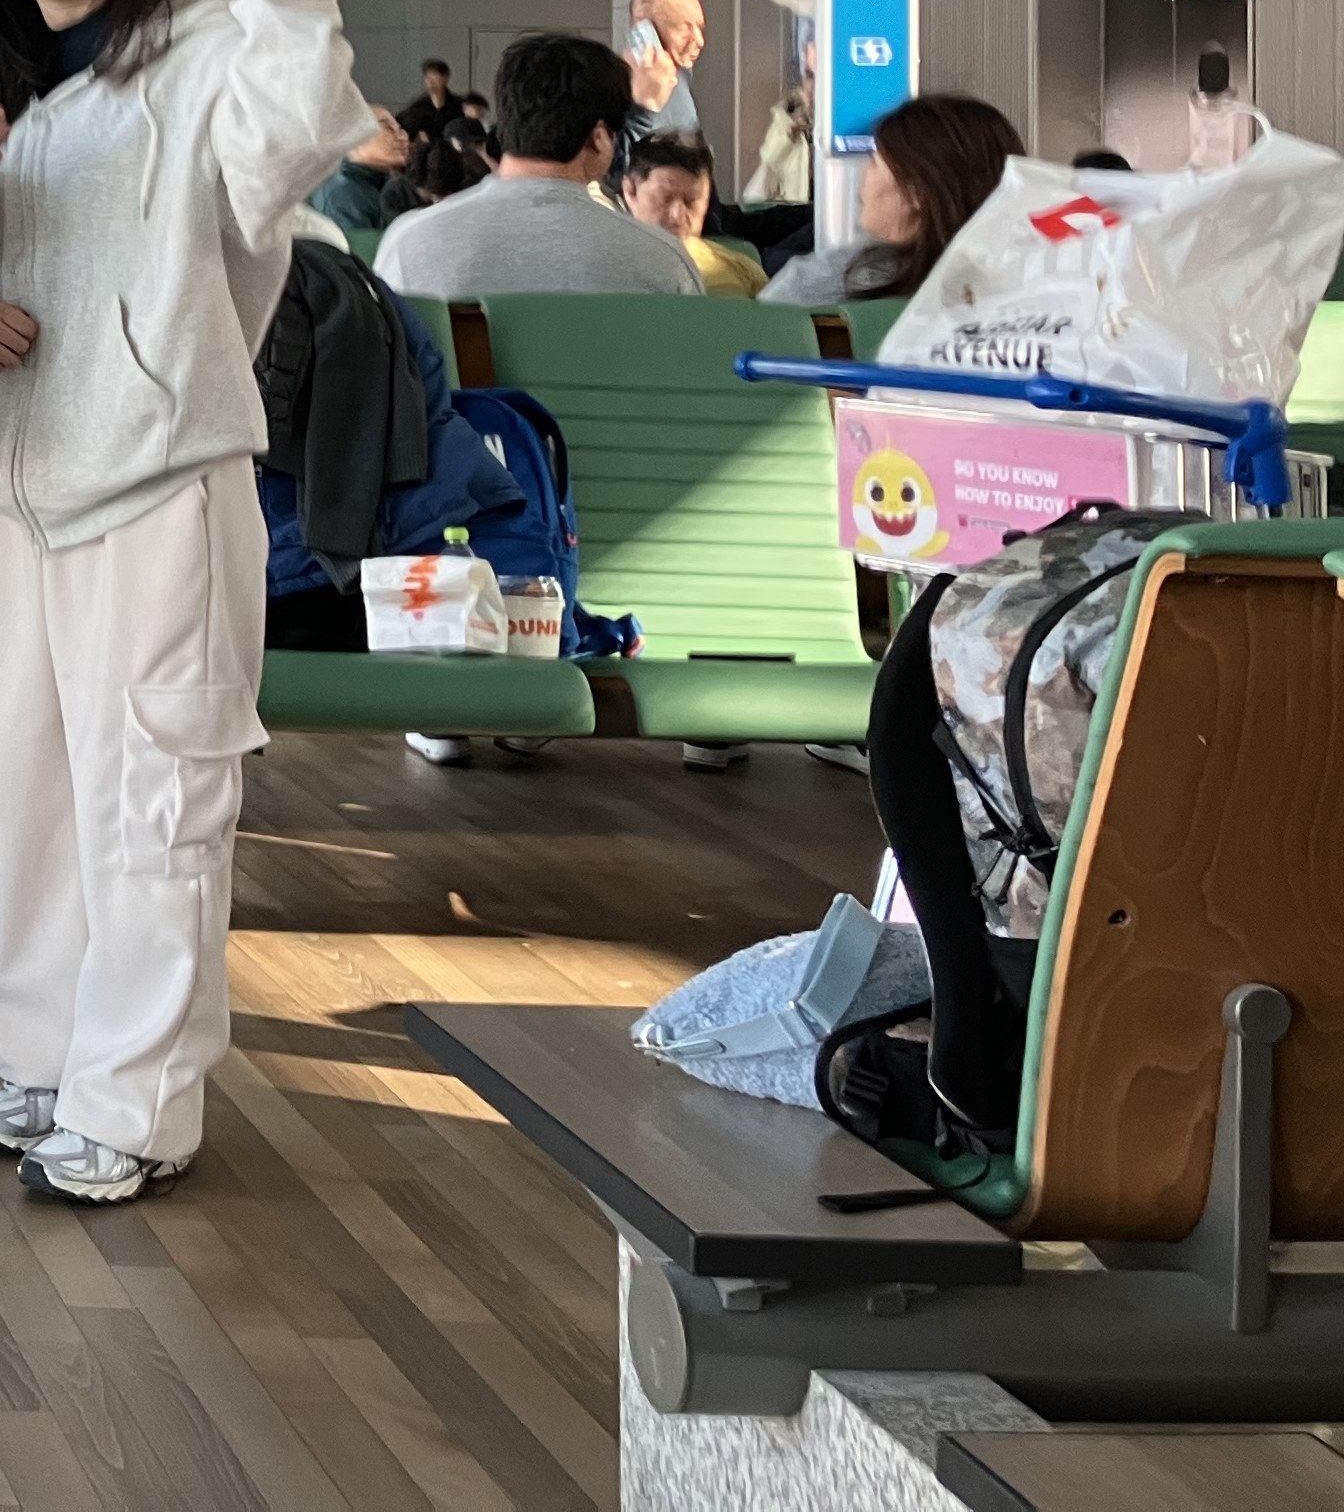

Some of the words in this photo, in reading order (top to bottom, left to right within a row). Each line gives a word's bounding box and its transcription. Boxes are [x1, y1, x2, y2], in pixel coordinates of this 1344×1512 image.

[978, 462, 1009, 482] YOU
[1012, 467, 1059, 488] KNOW
[954, 485, 990, 504] HOW
[992, 490, 1011, 509] TO
[1014, 493, 1063, 514] ENJOY
